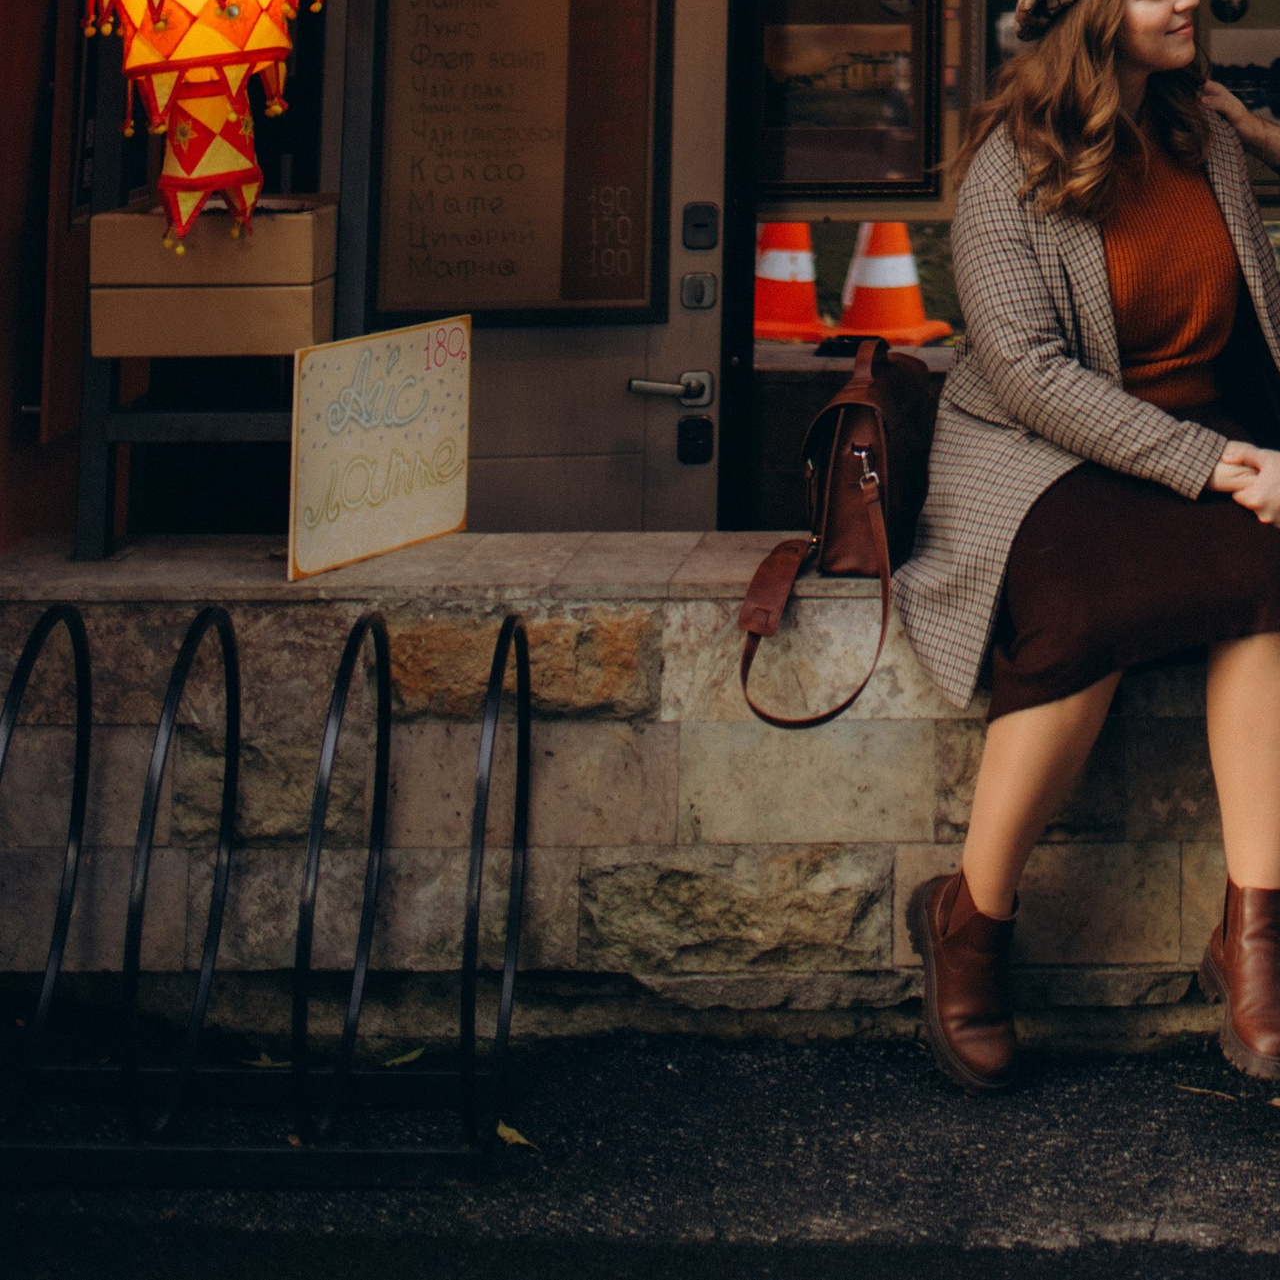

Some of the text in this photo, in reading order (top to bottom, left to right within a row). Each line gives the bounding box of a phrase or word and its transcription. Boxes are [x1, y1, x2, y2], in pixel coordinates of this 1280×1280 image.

[409, 155, 527, 185] Какао
[406, 184, 633, 219] Мате 190
[588, 248, 634, 279] 190
